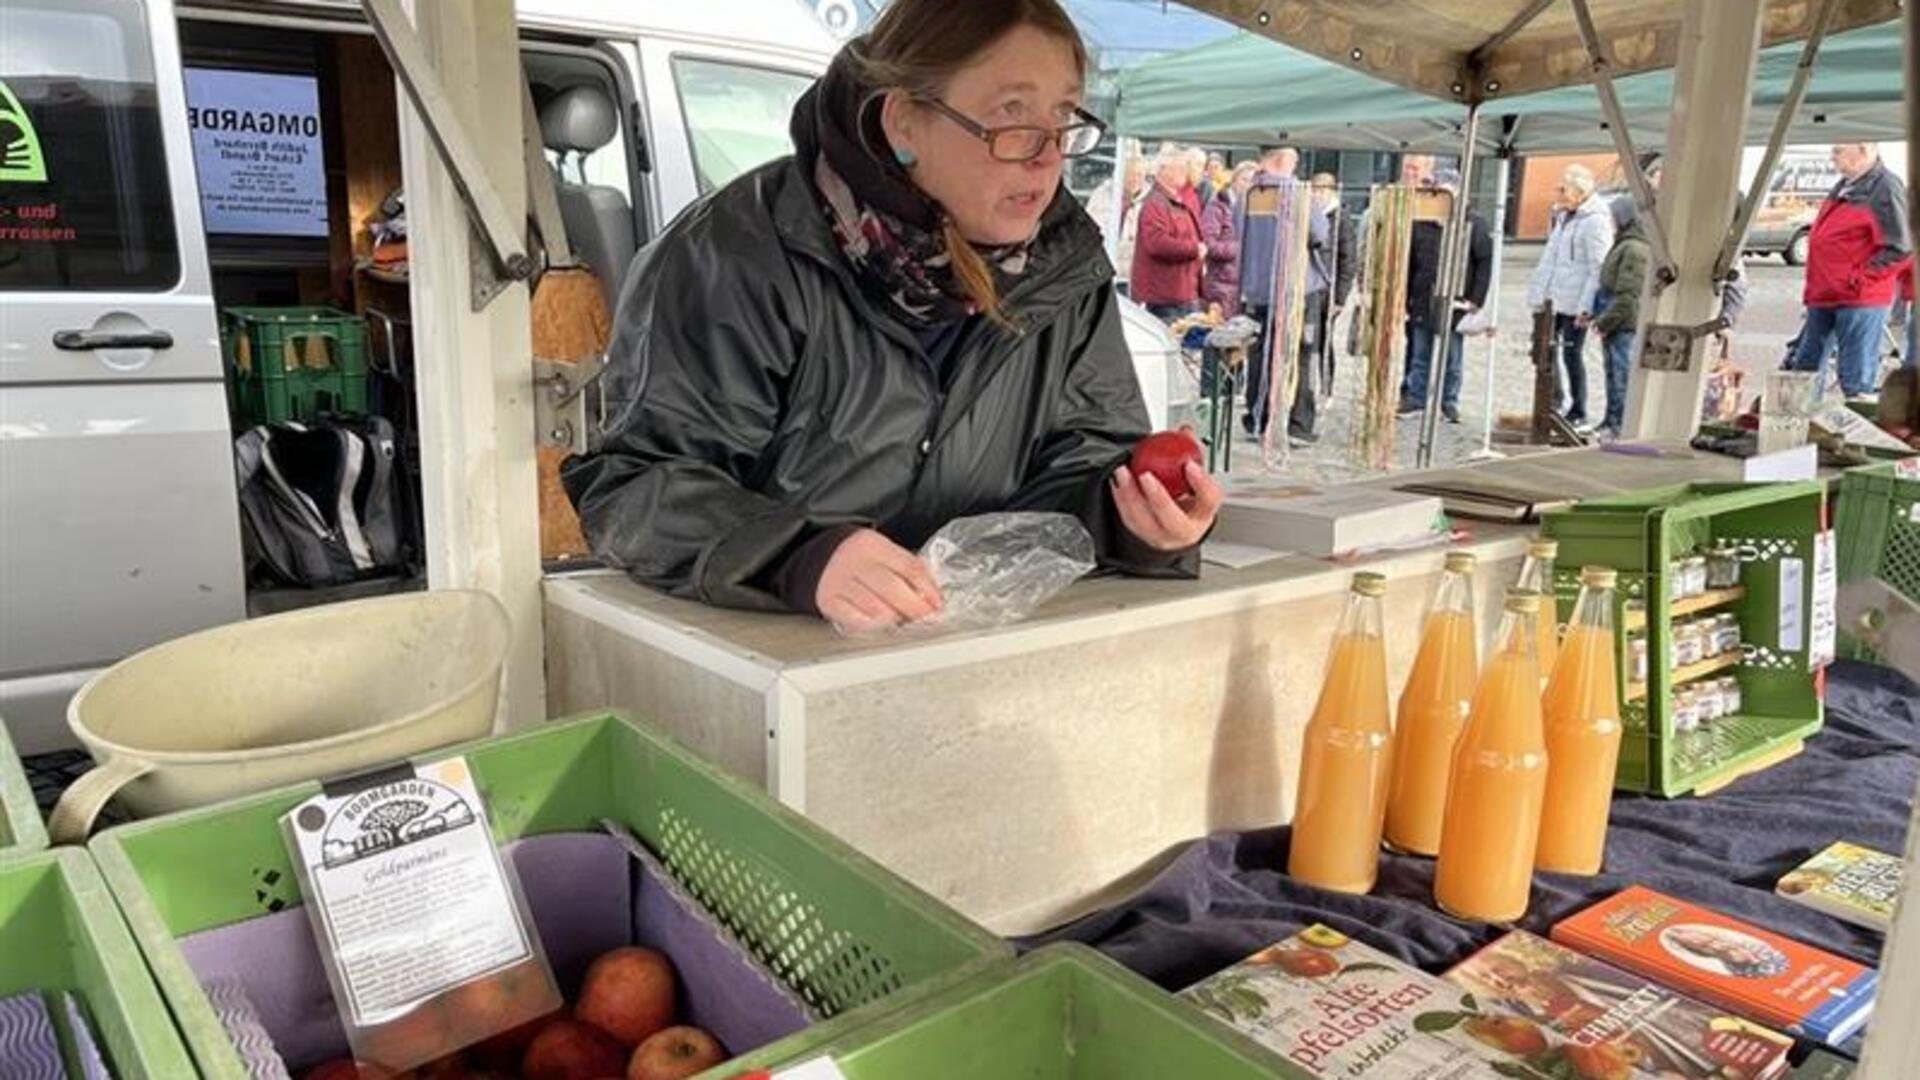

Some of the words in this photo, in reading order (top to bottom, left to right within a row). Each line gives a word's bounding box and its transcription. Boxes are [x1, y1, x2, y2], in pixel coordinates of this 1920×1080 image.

[18, 203, 57, 219] und
[343, 783, 436, 821] BOOMGARDEN
[1313, 976, 1379, 1019] Alte
